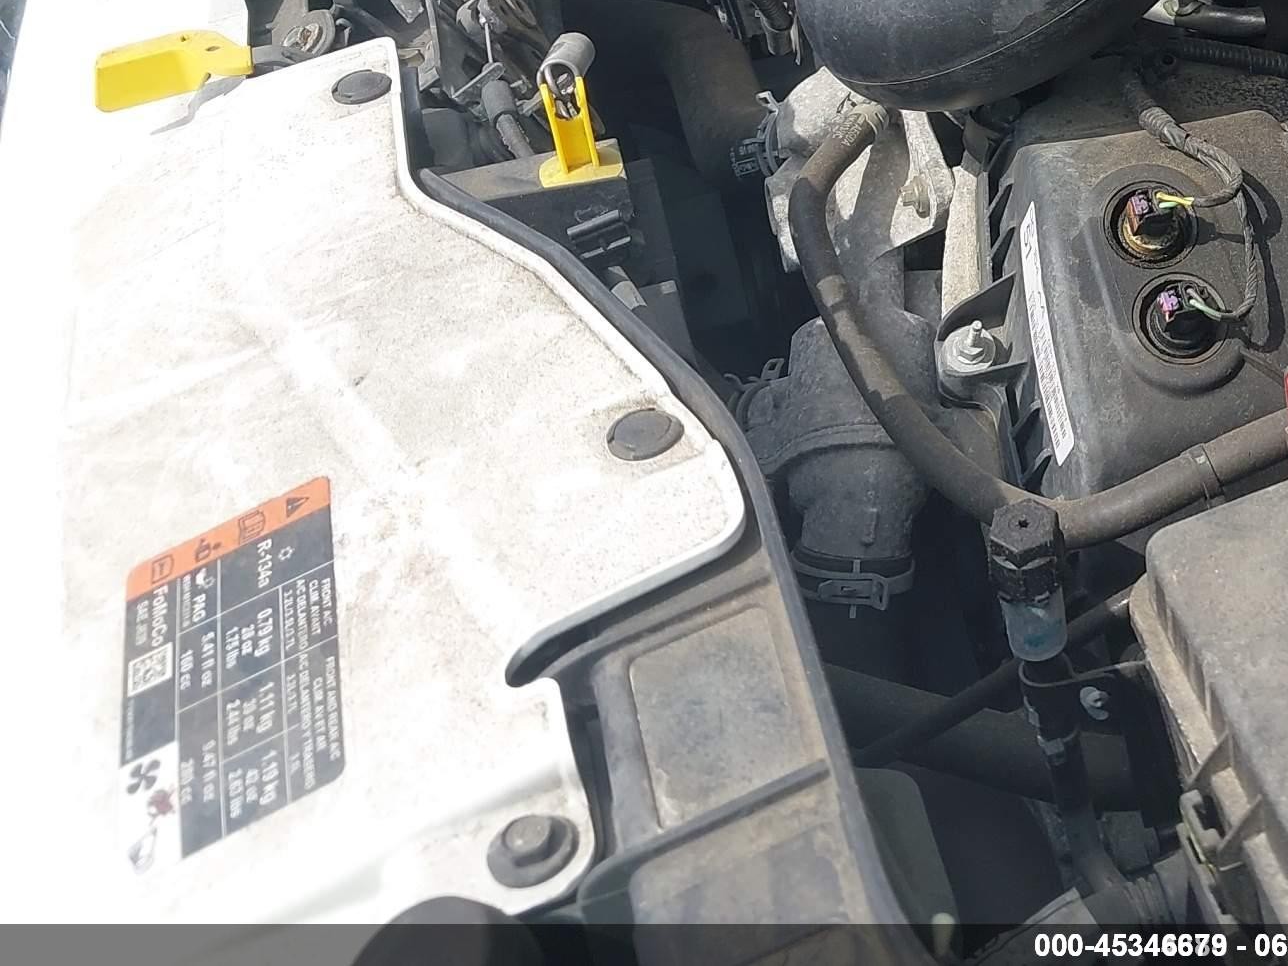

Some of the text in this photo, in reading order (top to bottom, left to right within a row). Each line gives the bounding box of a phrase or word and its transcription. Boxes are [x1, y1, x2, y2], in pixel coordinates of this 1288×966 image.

[257, 539, 272, 588] R-134a
[152, 585, 168, 646] FoMoCo
[192, 594, 206, 622] PAG
[254, 608, 272, 657] 0.79 kg
[256, 710, 275, 733] kg
[260, 780, 278, 805] kg
